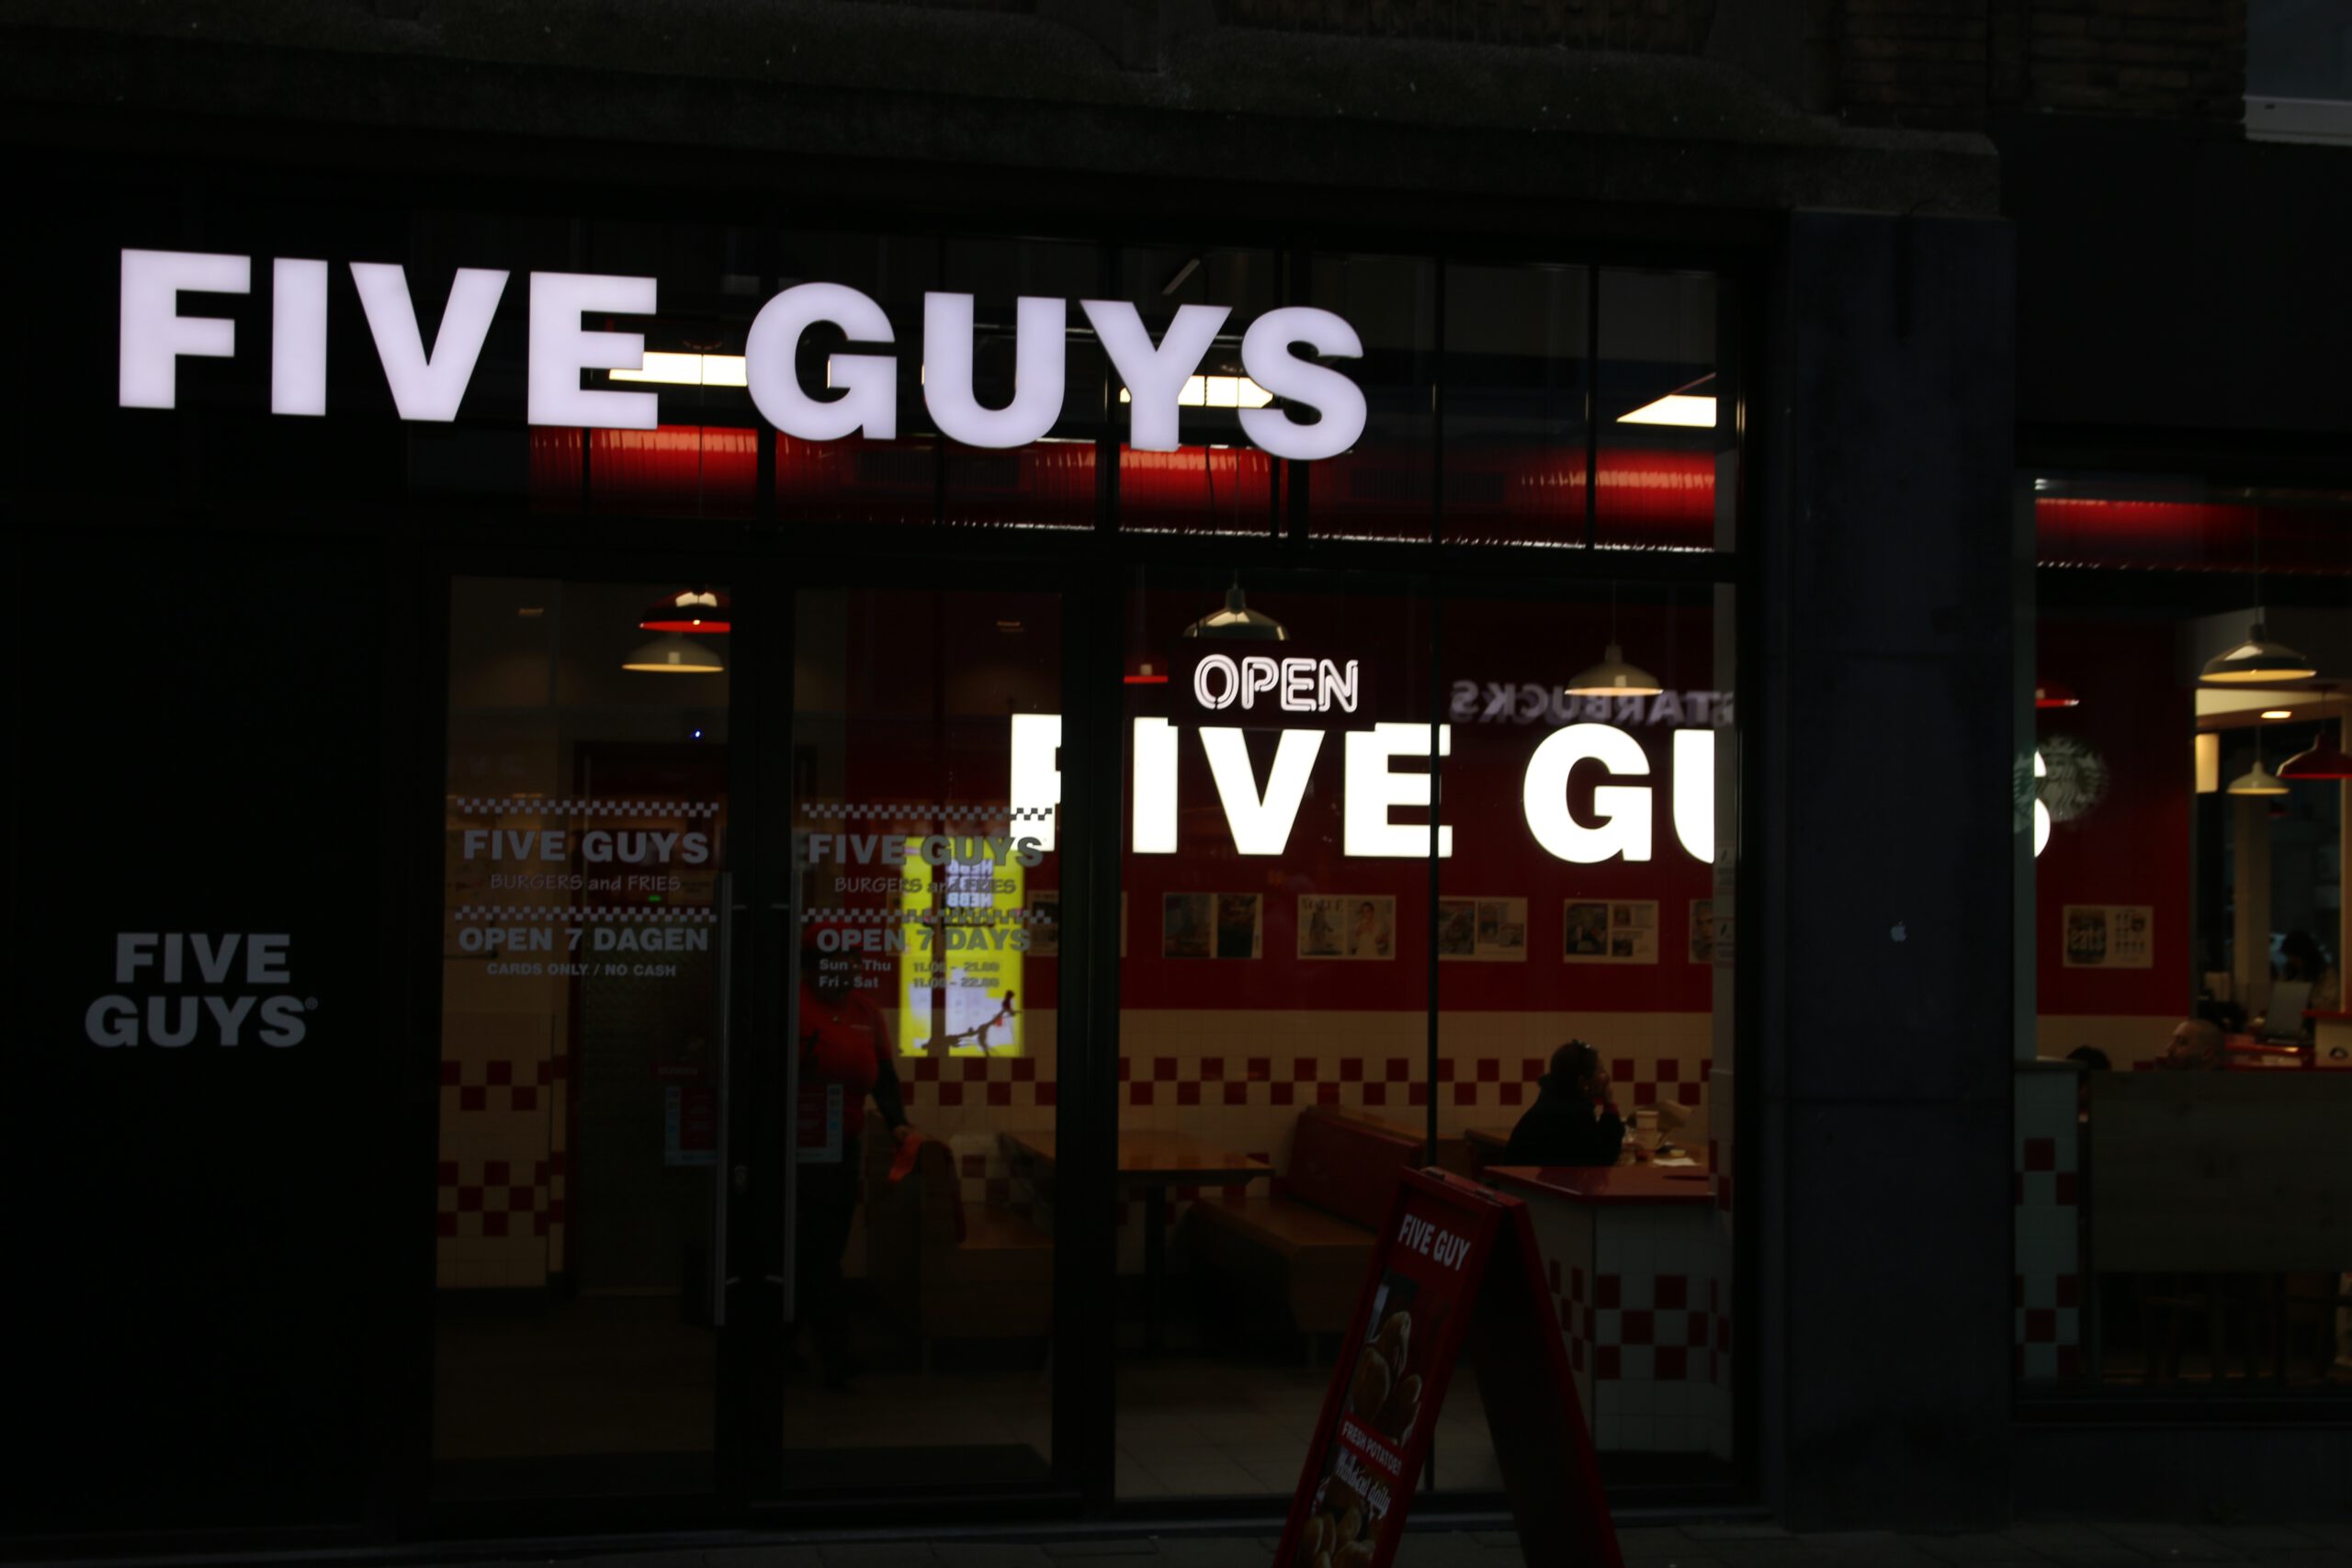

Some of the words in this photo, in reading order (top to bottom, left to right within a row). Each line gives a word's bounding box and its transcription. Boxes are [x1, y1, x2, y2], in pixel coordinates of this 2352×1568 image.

[118, 247, 659, 430] FIVE
[745, 281, 1368, 462] GUYS
[1194, 654, 1359, 713] OPEN
[464, 829, 566, 861] FIVE
[582, 830, 710, 864] GUYS
[808, 834, 907, 865] FIVE
[921, 835, 1045, 867] GUYS
[490, 874, 584, 890] BURGERS
[588, 874, 622, 891] and
[628, 874, 682, 892] FRIES
[835, 877, 922, 894] BURGERS
[965, 878, 1017, 895] FRIES
[459, 927, 552, 952] OPEN
[565, 927, 583, 952] 7
[594, 927, 708, 952] DAGEN
[817, 928, 905, 953] OPEN
[916, 929, 934, 951] 7
[944, 928, 1031, 953] DAYS
[115, 931, 291, 985] FIVE
[487, 963, 542, 976] CARDS
[548, 964, 589, 976] ONLY
[593, 964, 600, 976] /
[605, 964, 631, 976] NO
[633, 964, 677, 977] CASH
[819, 959, 848, 972] Sun
[863, 959, 892, 972] Thu
[818, 976, 840, 988] Fri
[854, 976, 879, 989] Sat
[1397, 1213, 1436, 1256] FIVE
[1433, 1229, 1471, 1271] GUY
[1341, 1420, 1367, 1450] FRESH
